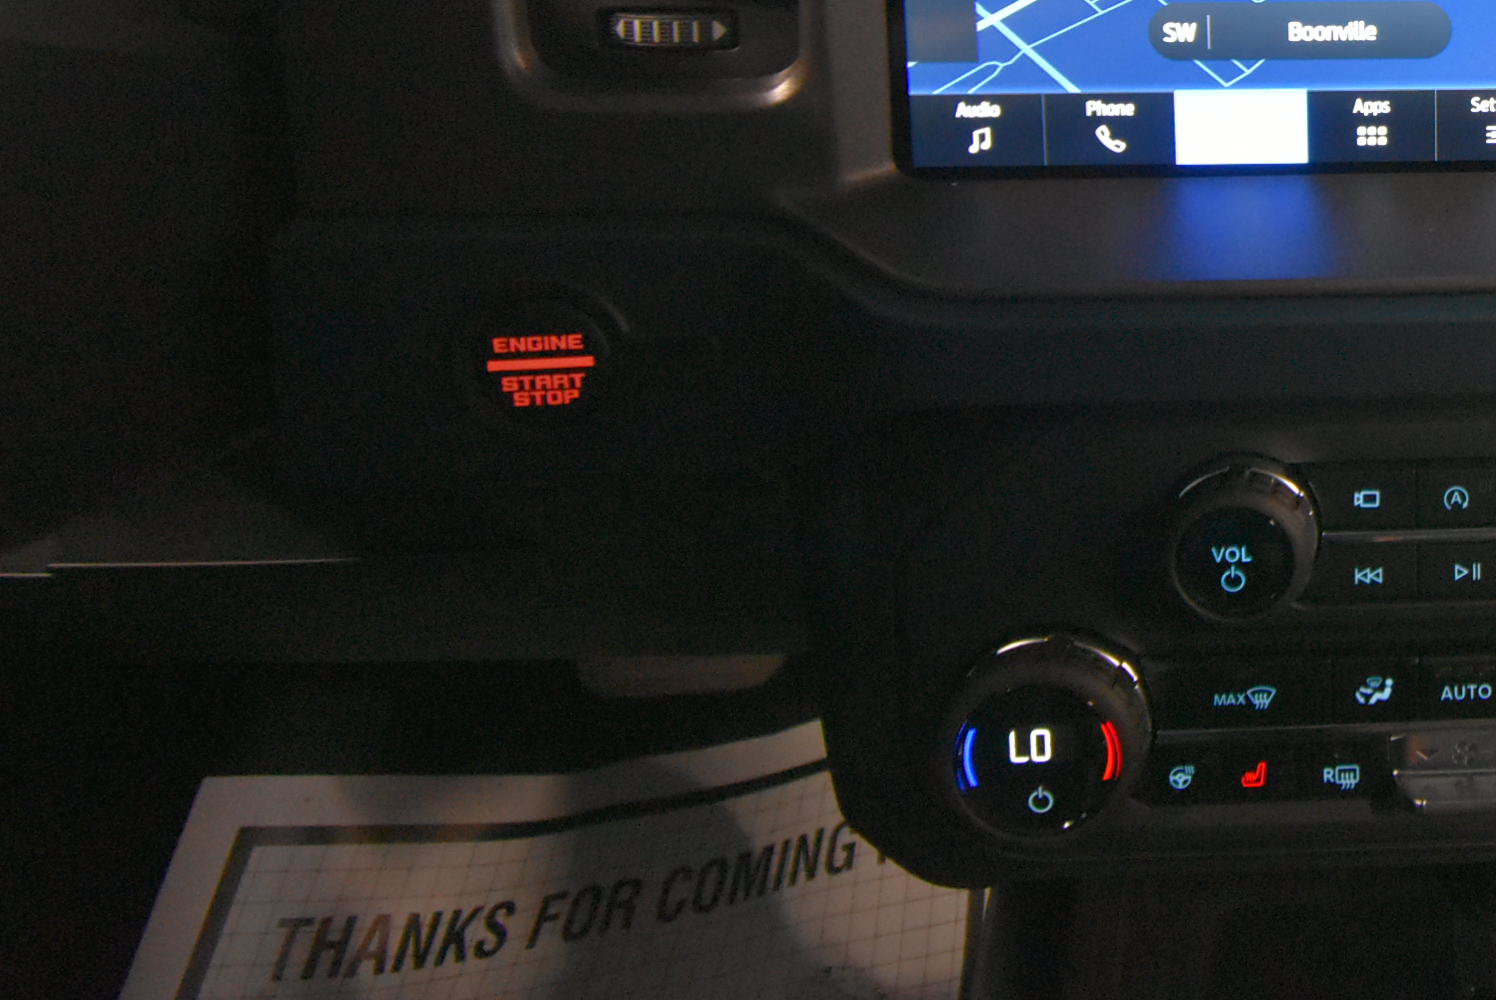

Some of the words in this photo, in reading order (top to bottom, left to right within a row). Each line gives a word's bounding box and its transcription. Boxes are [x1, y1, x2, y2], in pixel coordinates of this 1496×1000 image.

[1162, 21, 1197, 43] SW
[1287, 20, 1378, 43] Boonville
[955, 101, 1001, 119] Audio
[1085, 99, 1135, 118] Phone
[1352, 98, 1391, 117] Apps
[491, 333, 585, 354] ENGINE
[501, 372, 586, 393] START
[512, 389, 581, 408] STOP
[1211, 545, 1253, 564] VOL
[1213, 692, 1247, 707] MAX
[1440, 683, 1493, 702] AUTO
[271, 899, 516, 984] THANKS
[525, 876, 645, 951] FOR
[657, 820, 857, 925] COMING
